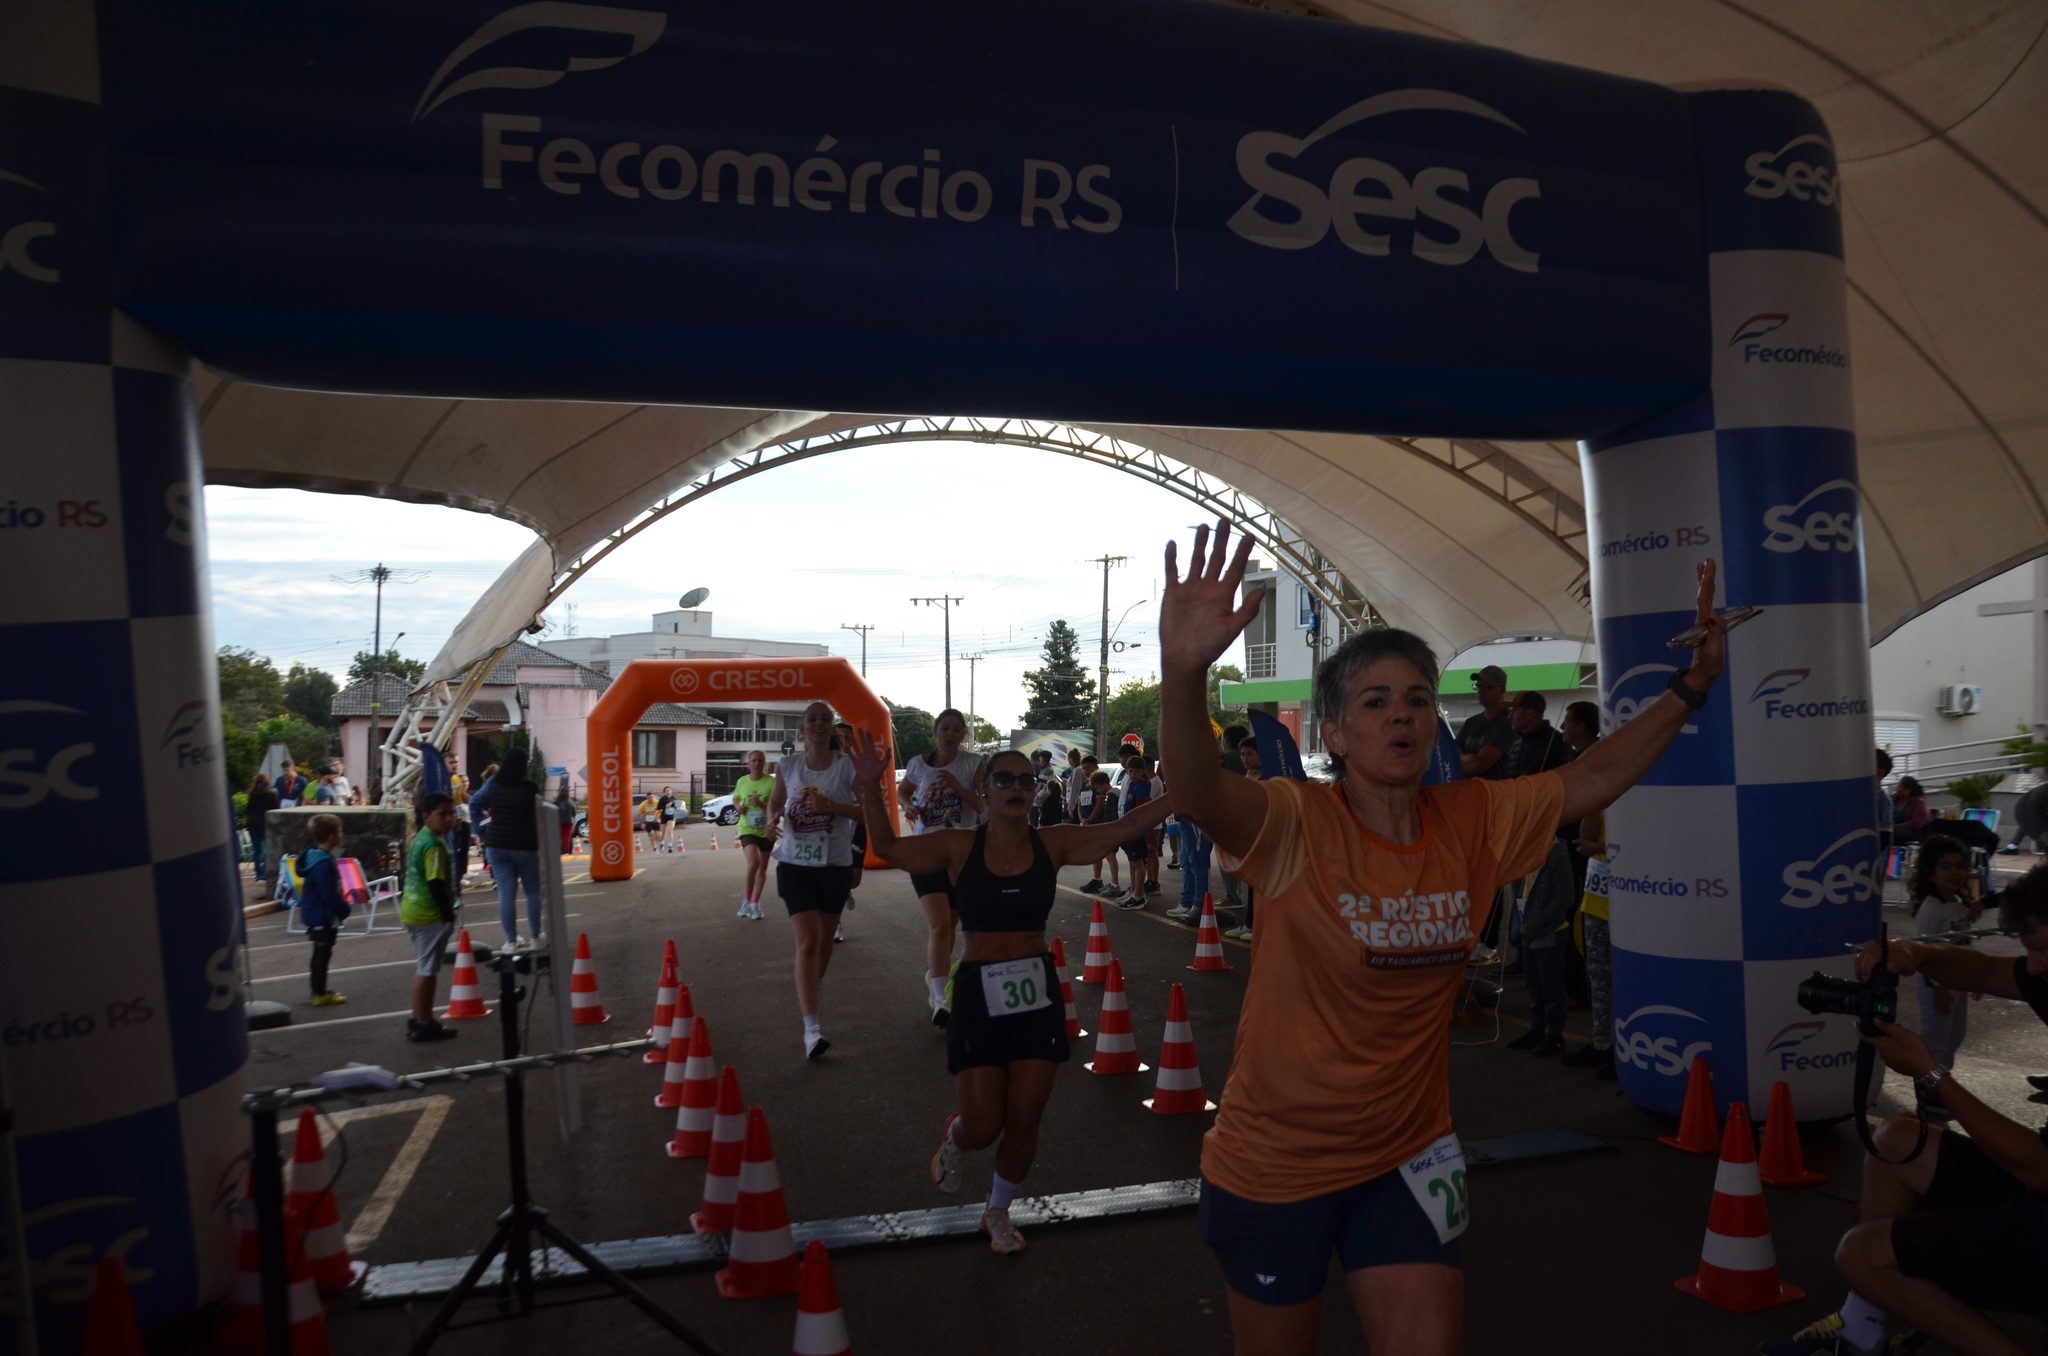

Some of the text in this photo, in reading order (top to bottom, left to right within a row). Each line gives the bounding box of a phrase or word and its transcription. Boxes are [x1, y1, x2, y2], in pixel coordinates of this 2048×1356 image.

[482, 112, 1123, 234] Fecomércio RS
[1225, 88, 1542, 273] Sesc
[1743, 133, 1839, 207] Ses
[57, 500, 107, 529] RS
[1761, 479, 1860, 553] Ses
[1676, 526, 1711, 547] RS
[707, 668, 813, 690] CRESOL
[602, 744, 622, 833] CRESOL
[793, 843, 823, 862] 254
[1695, 878, 1729, 898] RS
[1002, 978, 1037, 1009] 30
[106, 996, 154, 1029] RS
